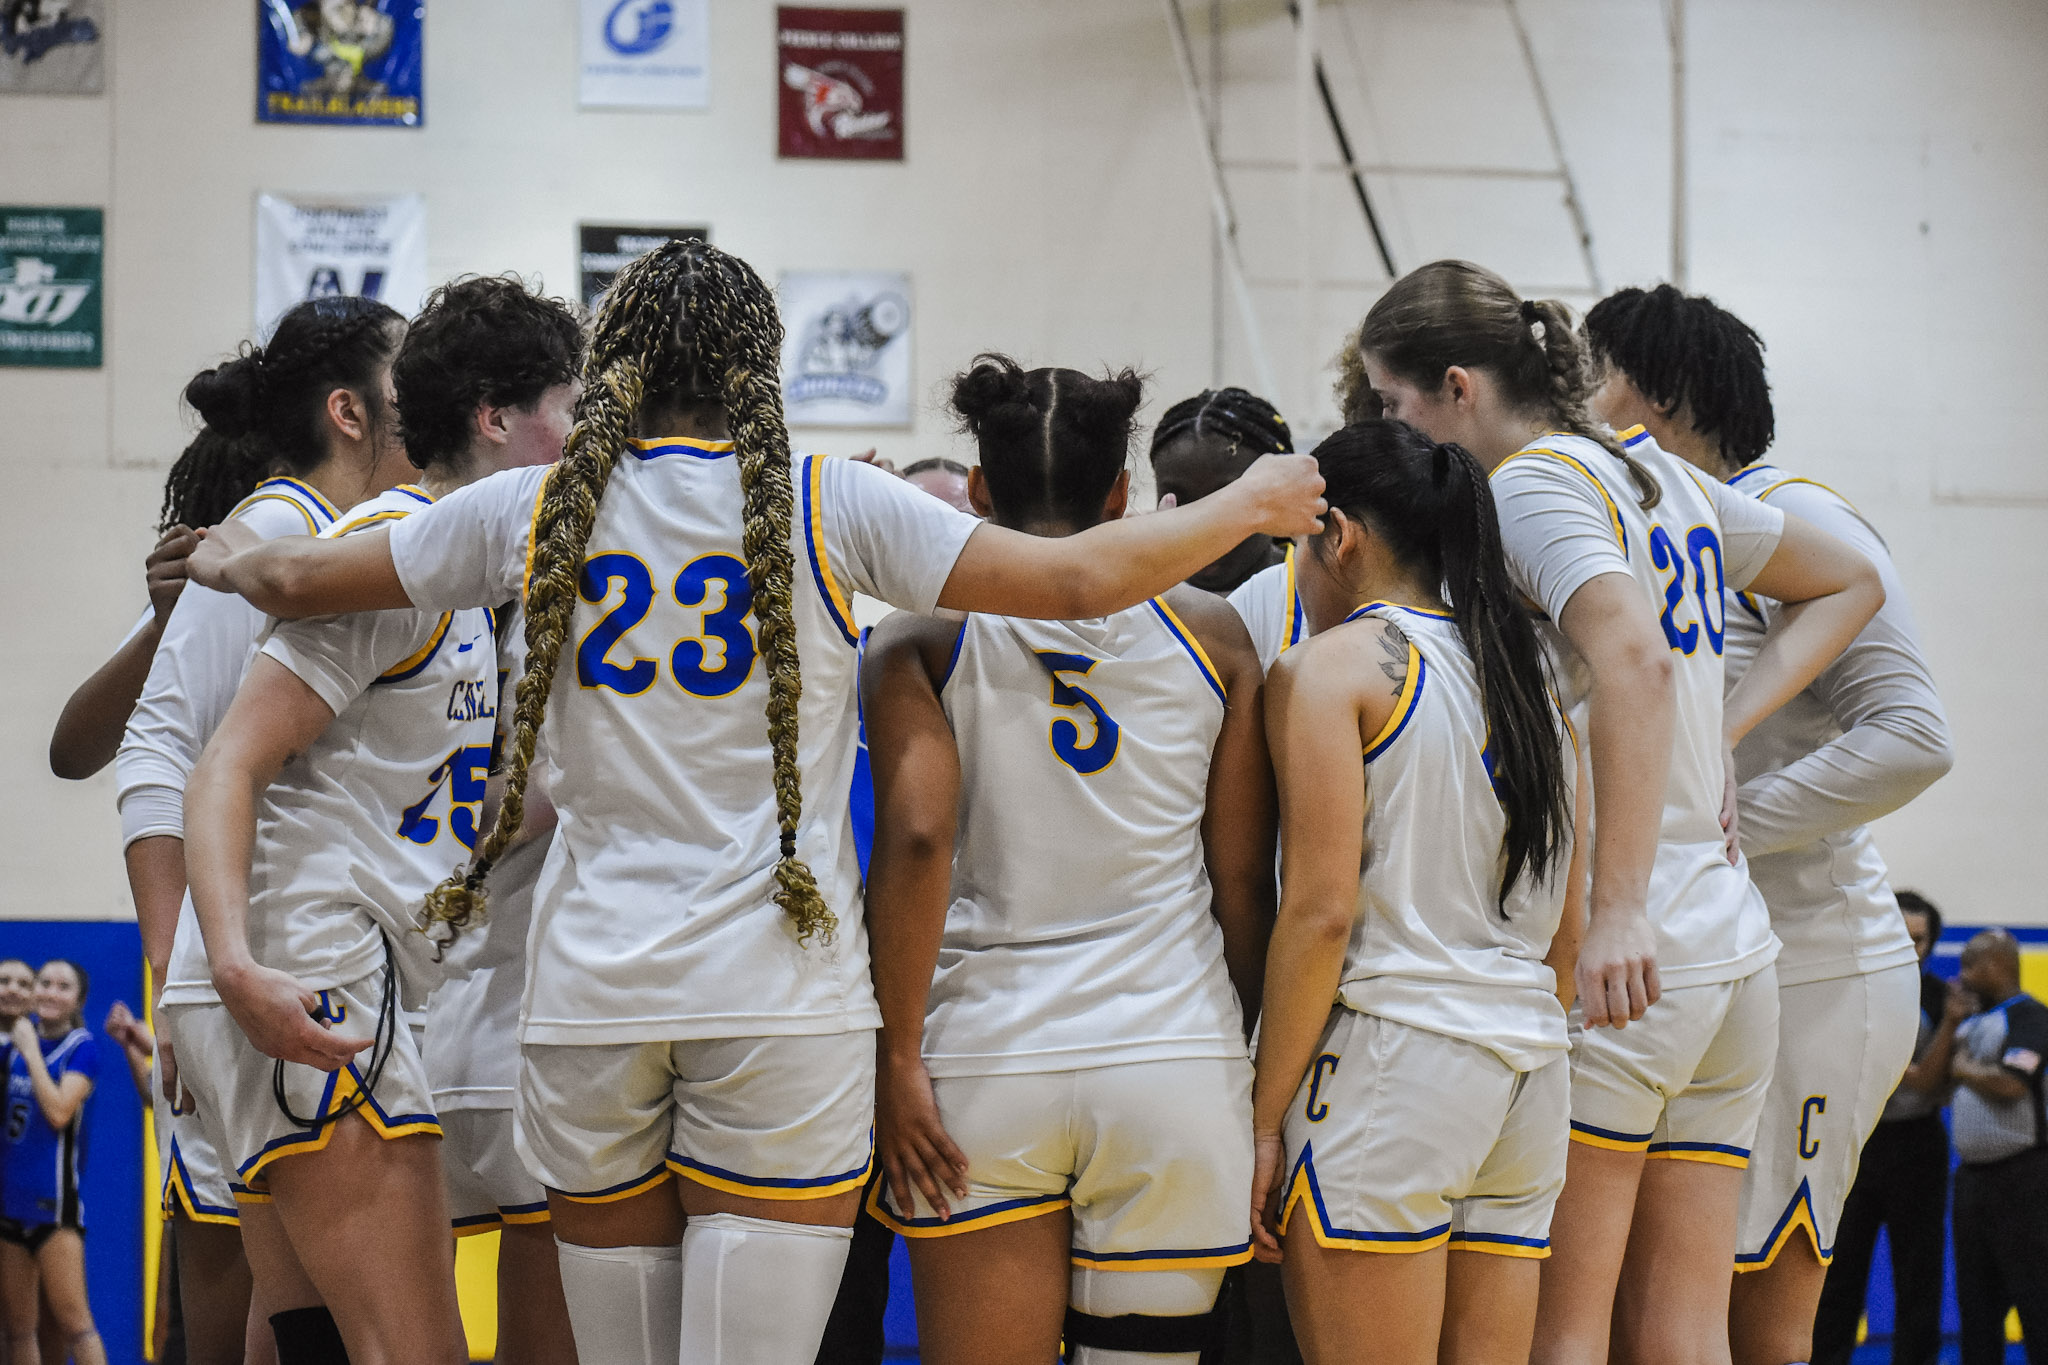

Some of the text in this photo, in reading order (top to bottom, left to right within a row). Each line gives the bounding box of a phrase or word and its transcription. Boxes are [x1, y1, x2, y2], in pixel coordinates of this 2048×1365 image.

[576, 550, 761, 699] 23
[1648, 523, 1724, 658] 20
[1032, 648, 1121, 776] 5
[395, 743, 493, 854] 25
[1305, 1052, 1341, 1124] C
[1796, 1094, 1827, 1160] C
